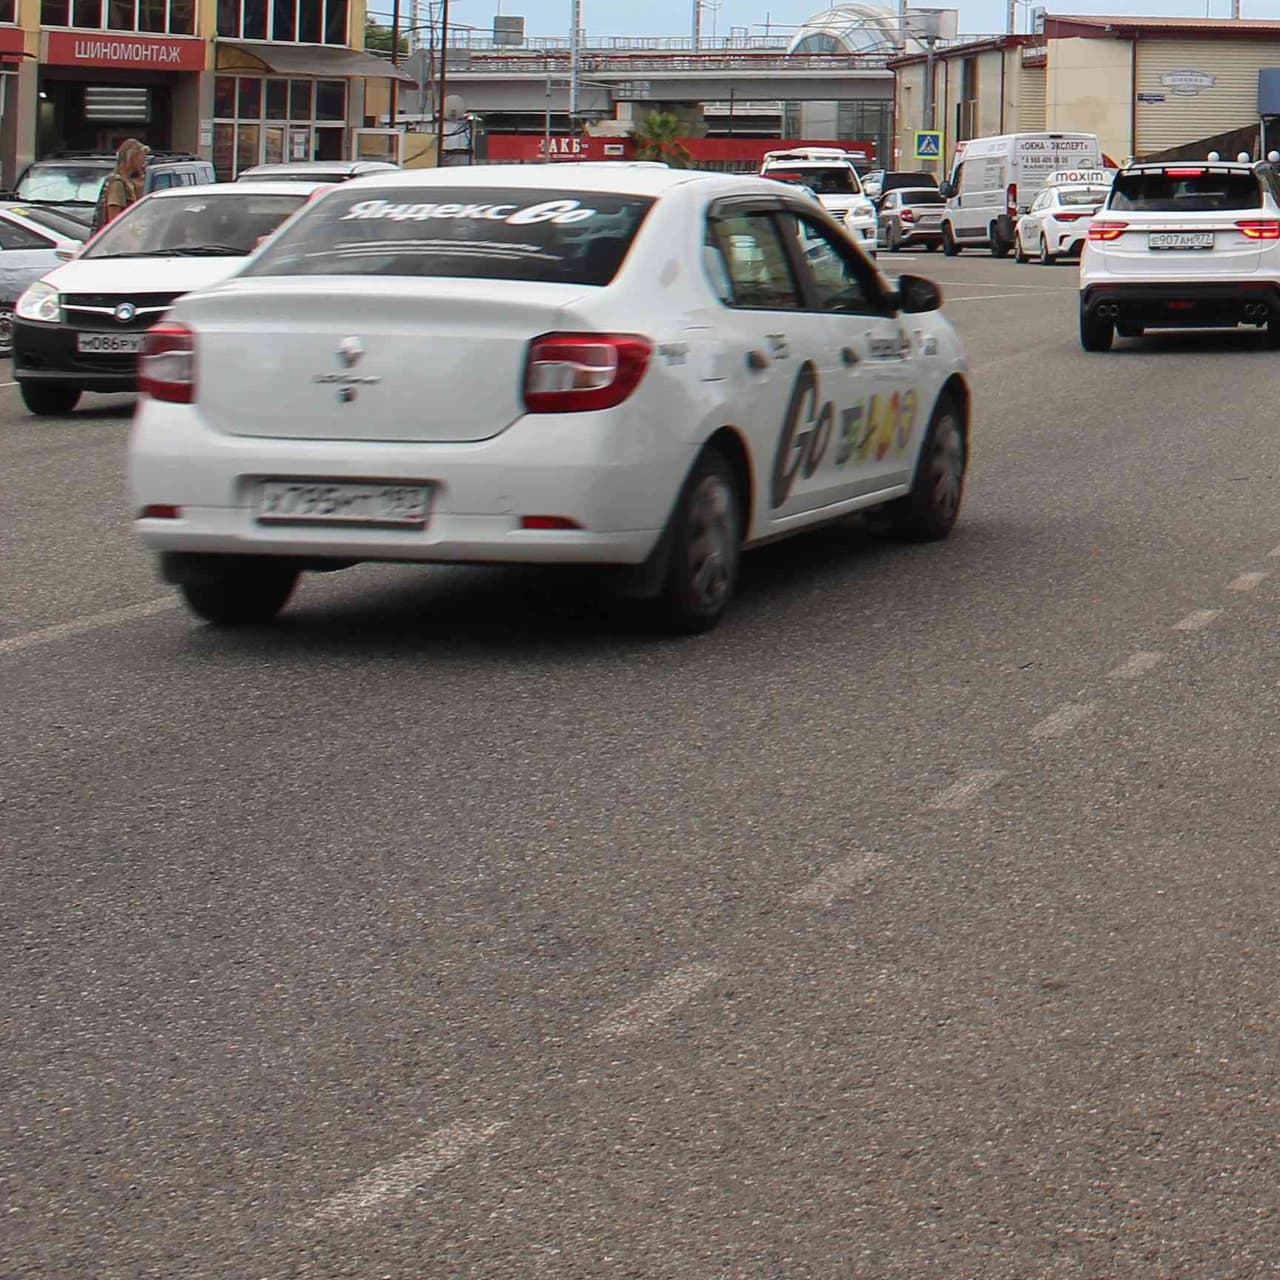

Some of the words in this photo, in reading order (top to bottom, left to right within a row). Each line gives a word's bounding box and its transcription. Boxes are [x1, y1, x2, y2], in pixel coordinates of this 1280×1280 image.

[74, 40, 181, 62] ШИНОМОНТАЖ
[549, 138, 581, 153] АКБ
[1055, 171, 1104, 182] maxim
[340, 200, 519, 221] Яндекс
[505, 200, 598, 225] Go
